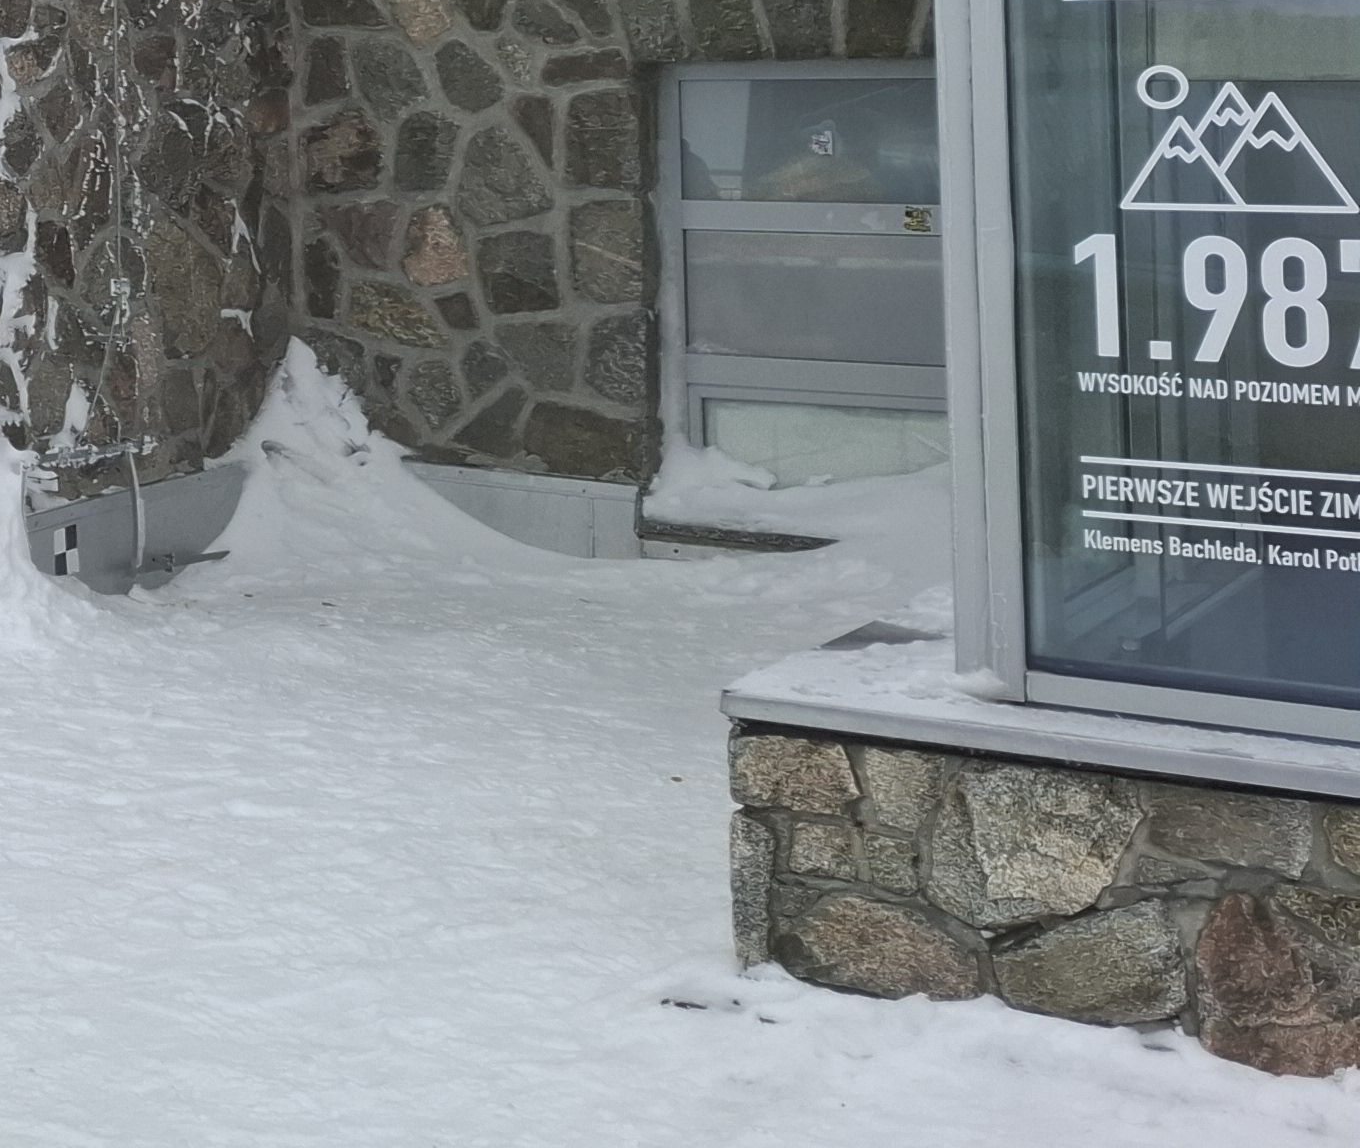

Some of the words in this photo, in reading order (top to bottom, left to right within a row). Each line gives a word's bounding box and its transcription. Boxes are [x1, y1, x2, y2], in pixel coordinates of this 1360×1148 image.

[1077, 371, 1183, 397] WYSOKOŚĆ
[1189, 377, 1228, 400] NAD
[1235, 380, 1340, 406] POZIOMEM
[1082, 473, 1200, 507] PIERWSZE
[1206, 481, 1314, 516] WEJŚCIE
[1084, 529, 1163, 556] Klemens
[1169, 536, 1262, 565] Bachleda,
[1268, 544, 1321, 569] Karol
[1326, 549, 1360, 572] Pot
